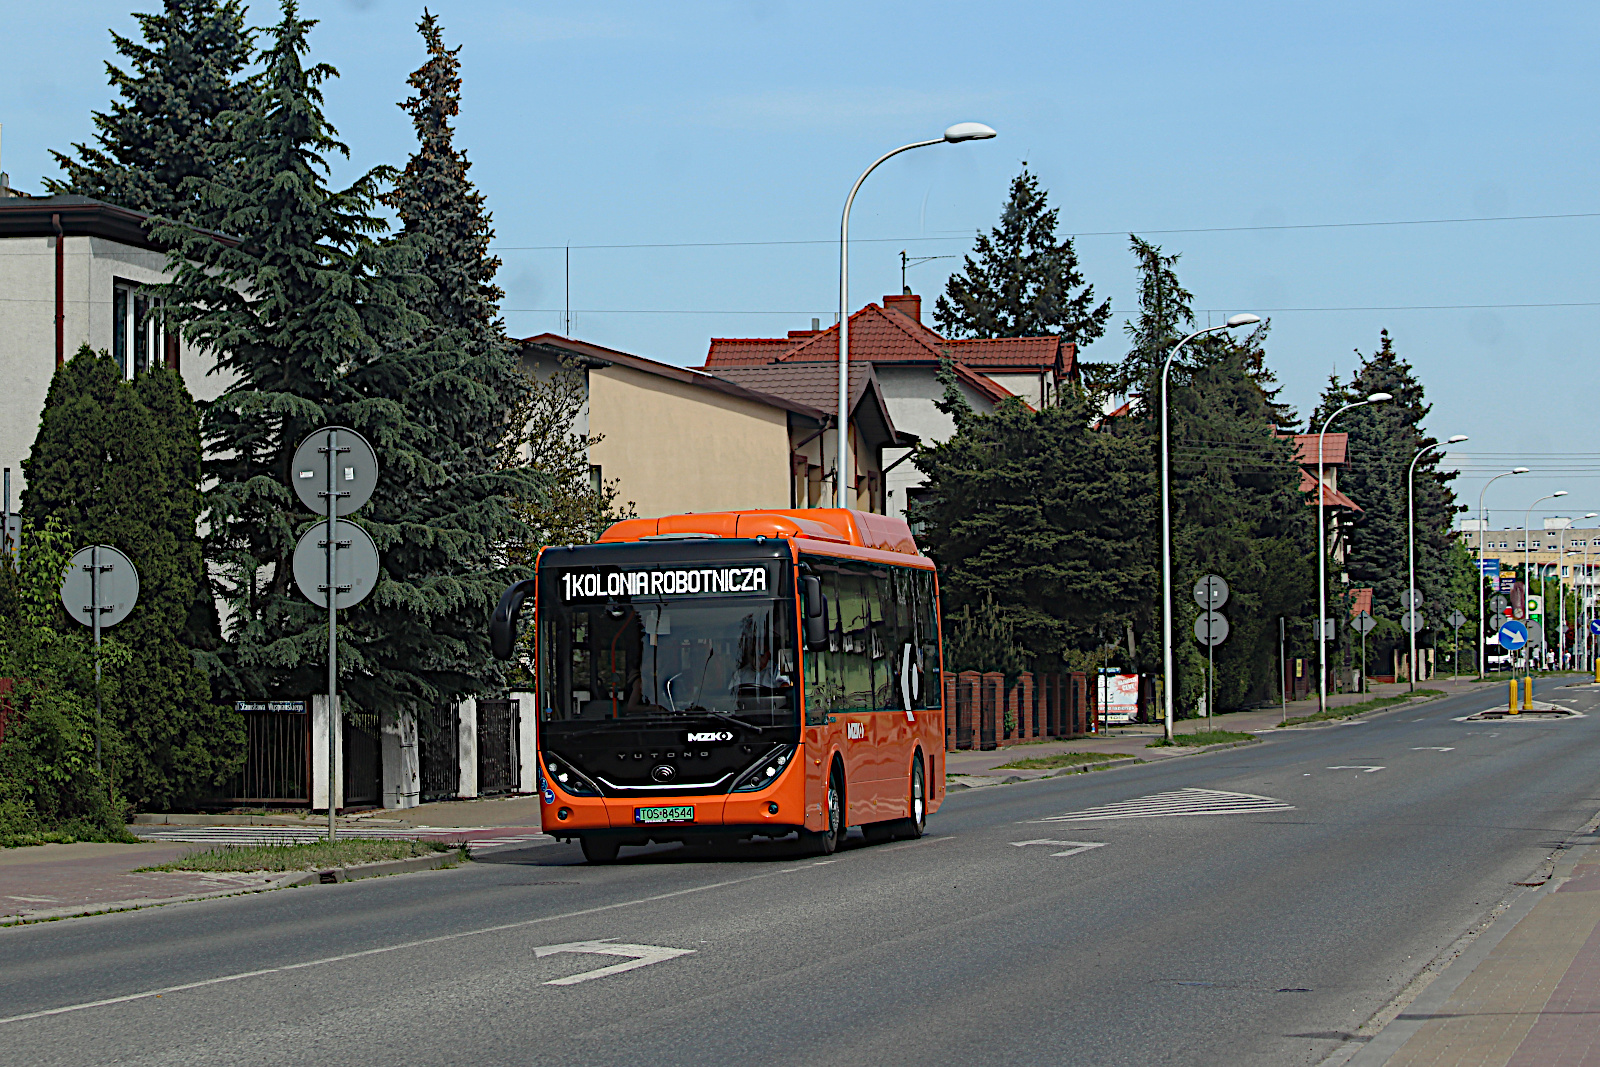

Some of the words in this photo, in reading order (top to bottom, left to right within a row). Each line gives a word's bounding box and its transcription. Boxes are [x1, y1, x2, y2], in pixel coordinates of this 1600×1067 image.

[562, 572, 571, 600] 1
[572, 568, 648, 597] KOLONIA
[651, 567, 766, 595] ROBOTNICZA
[618, 751, 709, 760] YUTONG
[641, 808, 660, 820] TOS
[662, 807, 693, 819] 84544
